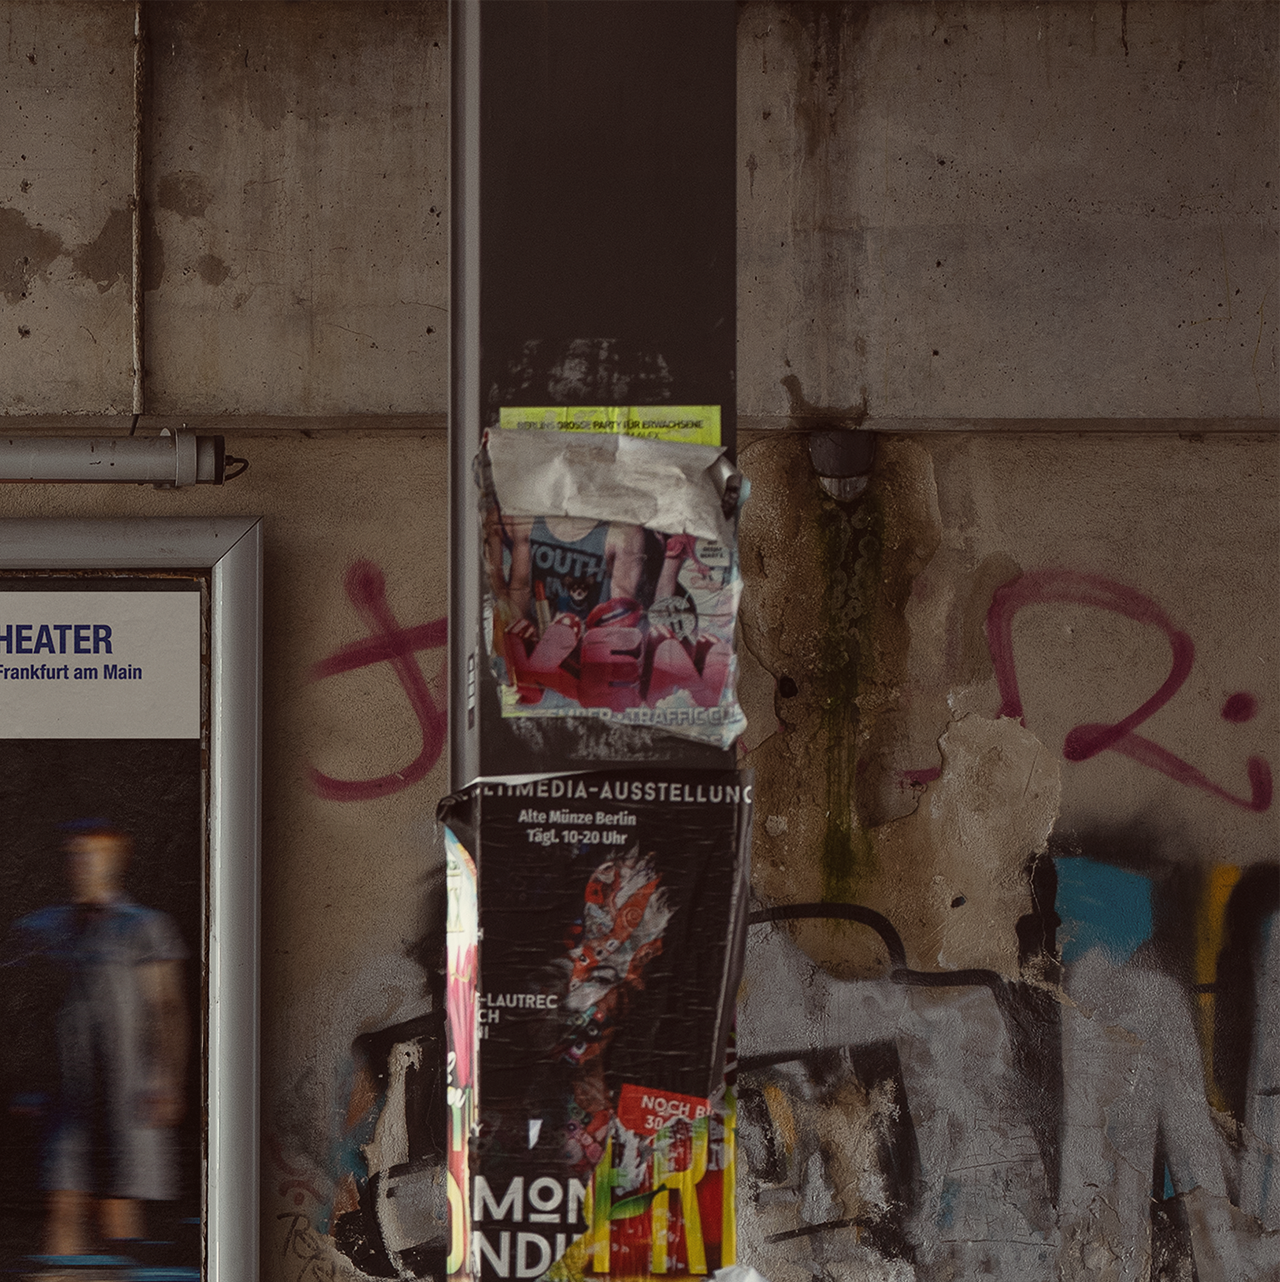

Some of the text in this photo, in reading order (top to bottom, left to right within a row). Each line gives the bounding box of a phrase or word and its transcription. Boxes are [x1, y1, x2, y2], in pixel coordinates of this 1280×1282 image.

[74, 667, 98, 680] am
[104, 664, 142, 680] Main
[518, 809, 637, 825] Alte Münze Berlin
[527, 829, 628, 846] Tägl. 10-20 Uhr
[641, 1095, 691, 1116] NOCH
